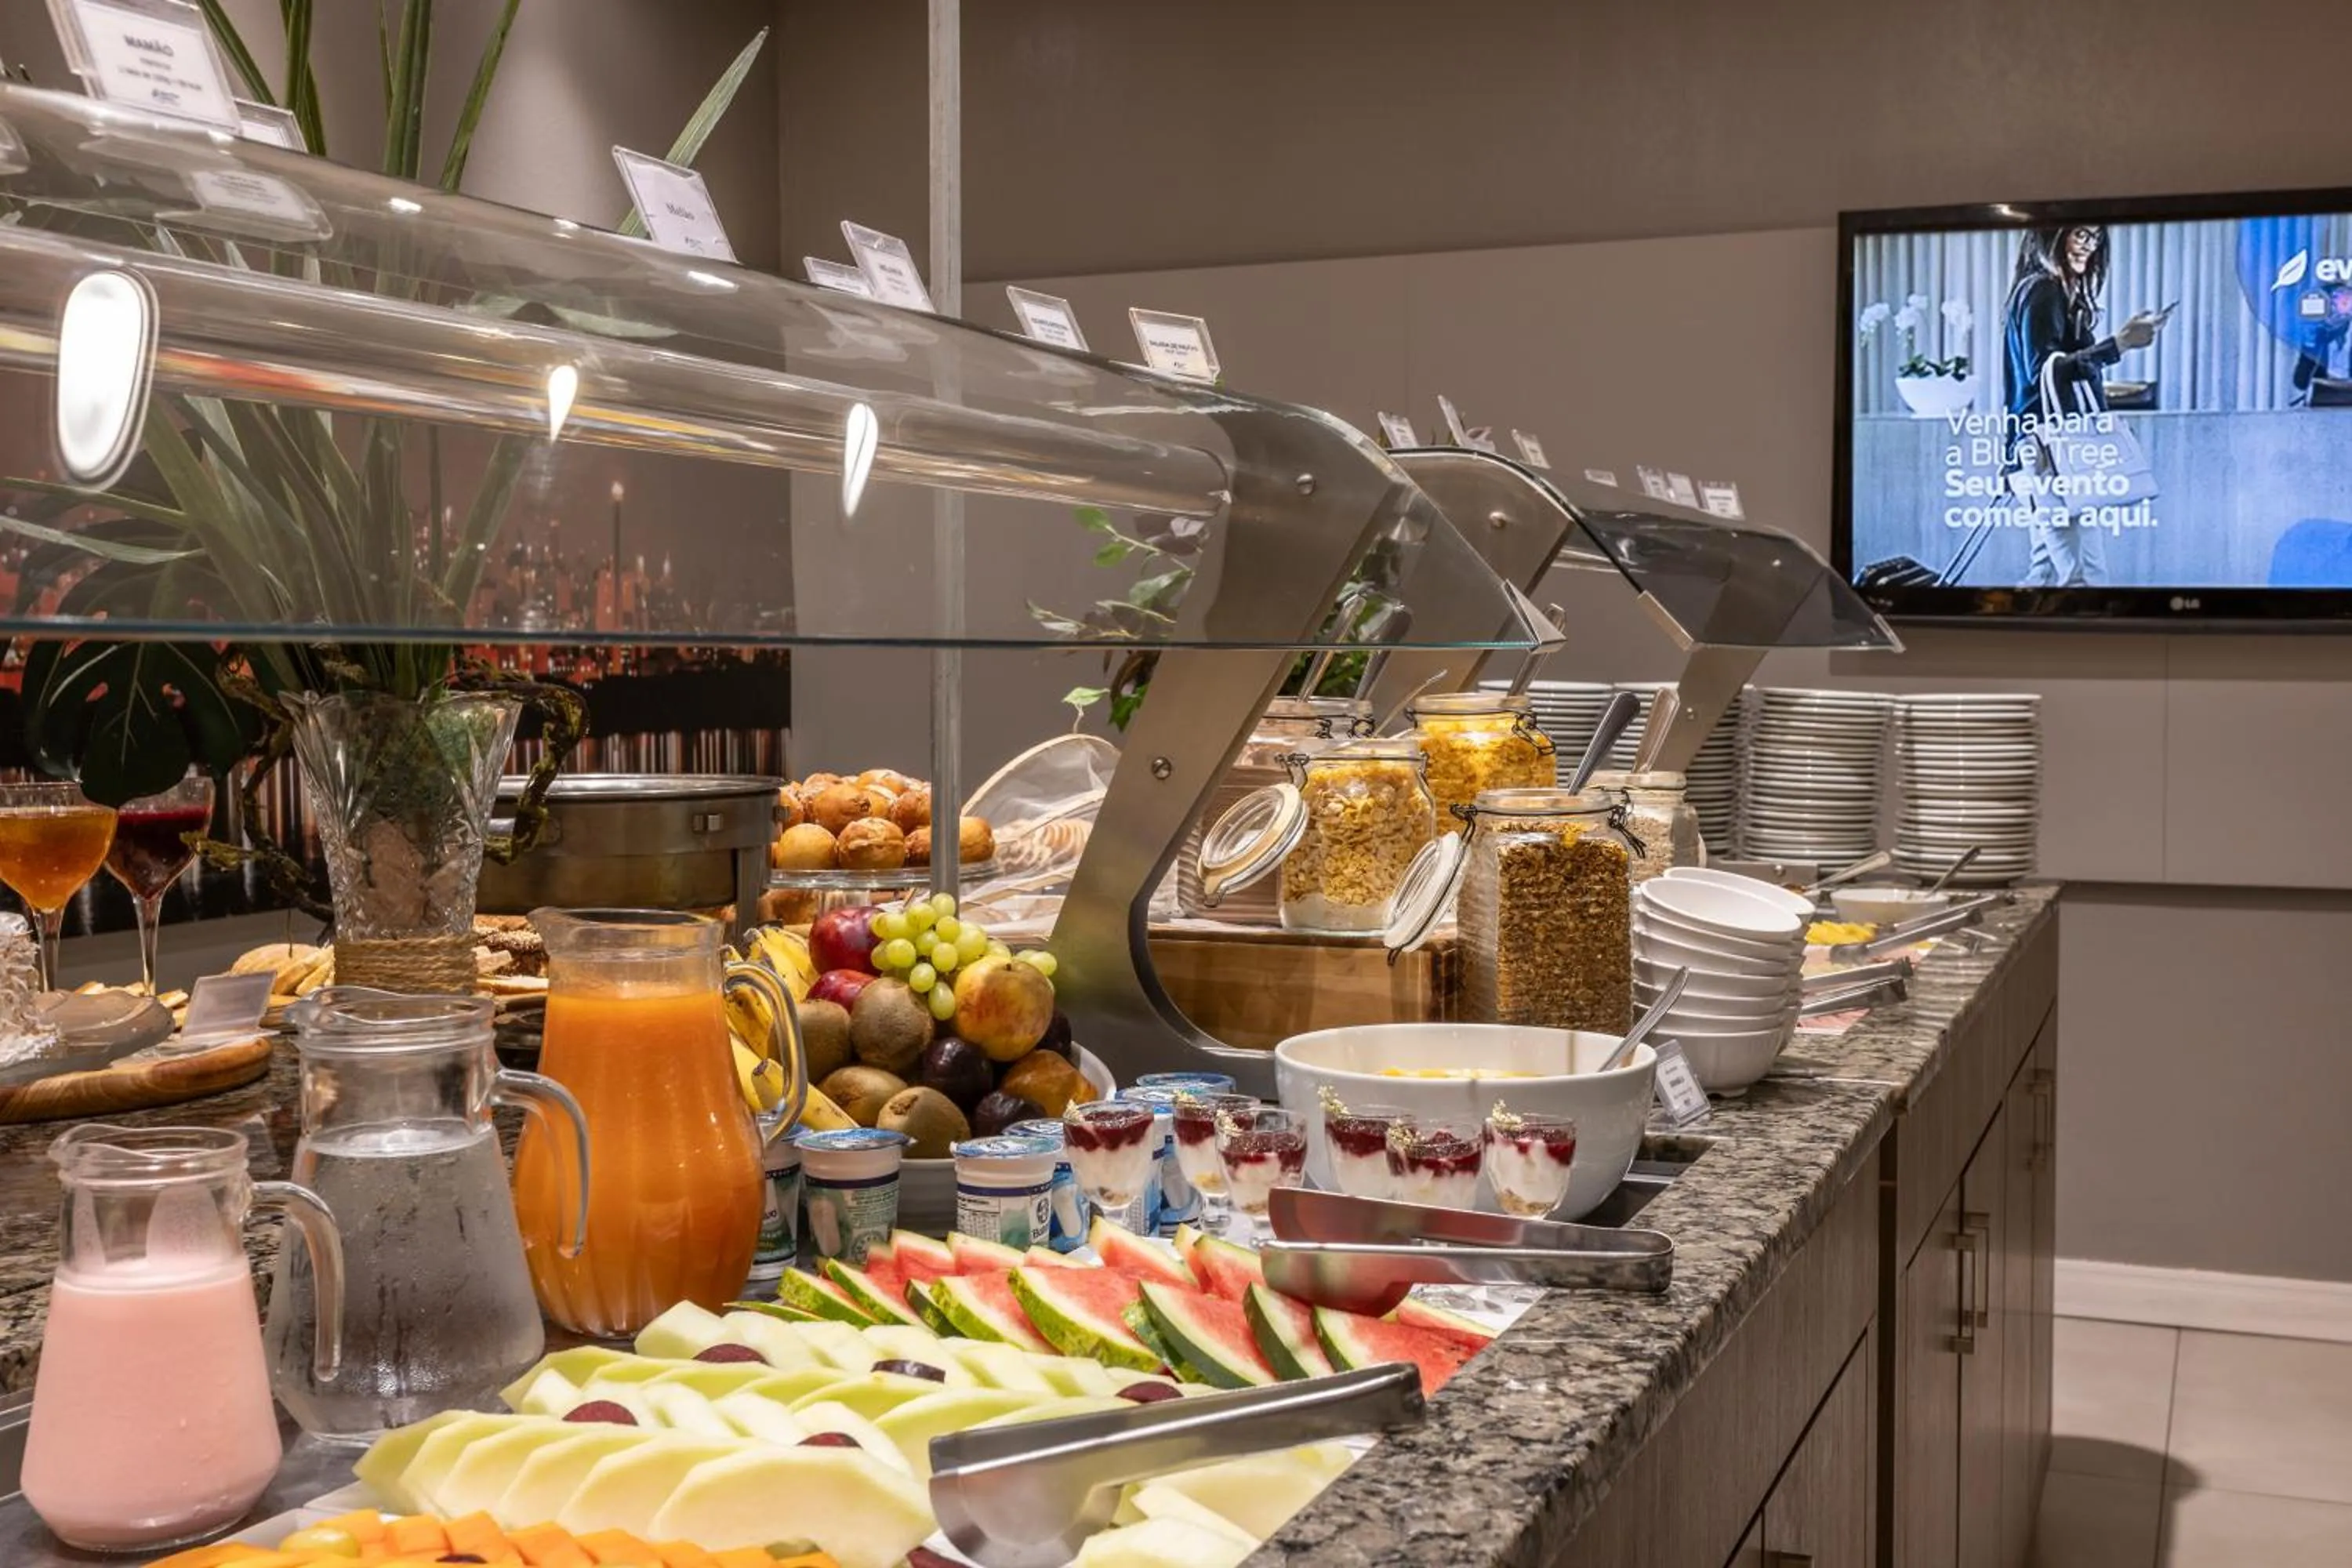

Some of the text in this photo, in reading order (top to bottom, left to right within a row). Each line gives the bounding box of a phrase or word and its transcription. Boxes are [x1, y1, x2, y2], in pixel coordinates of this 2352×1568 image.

[1945, 406, 2114, 444] Venha para
[1945, 437, 2124, 466] a Blue Tree.
[1944, 470, 2130, 497] Seu evento
[1944, 498, 2158, 536] começa aqui.
